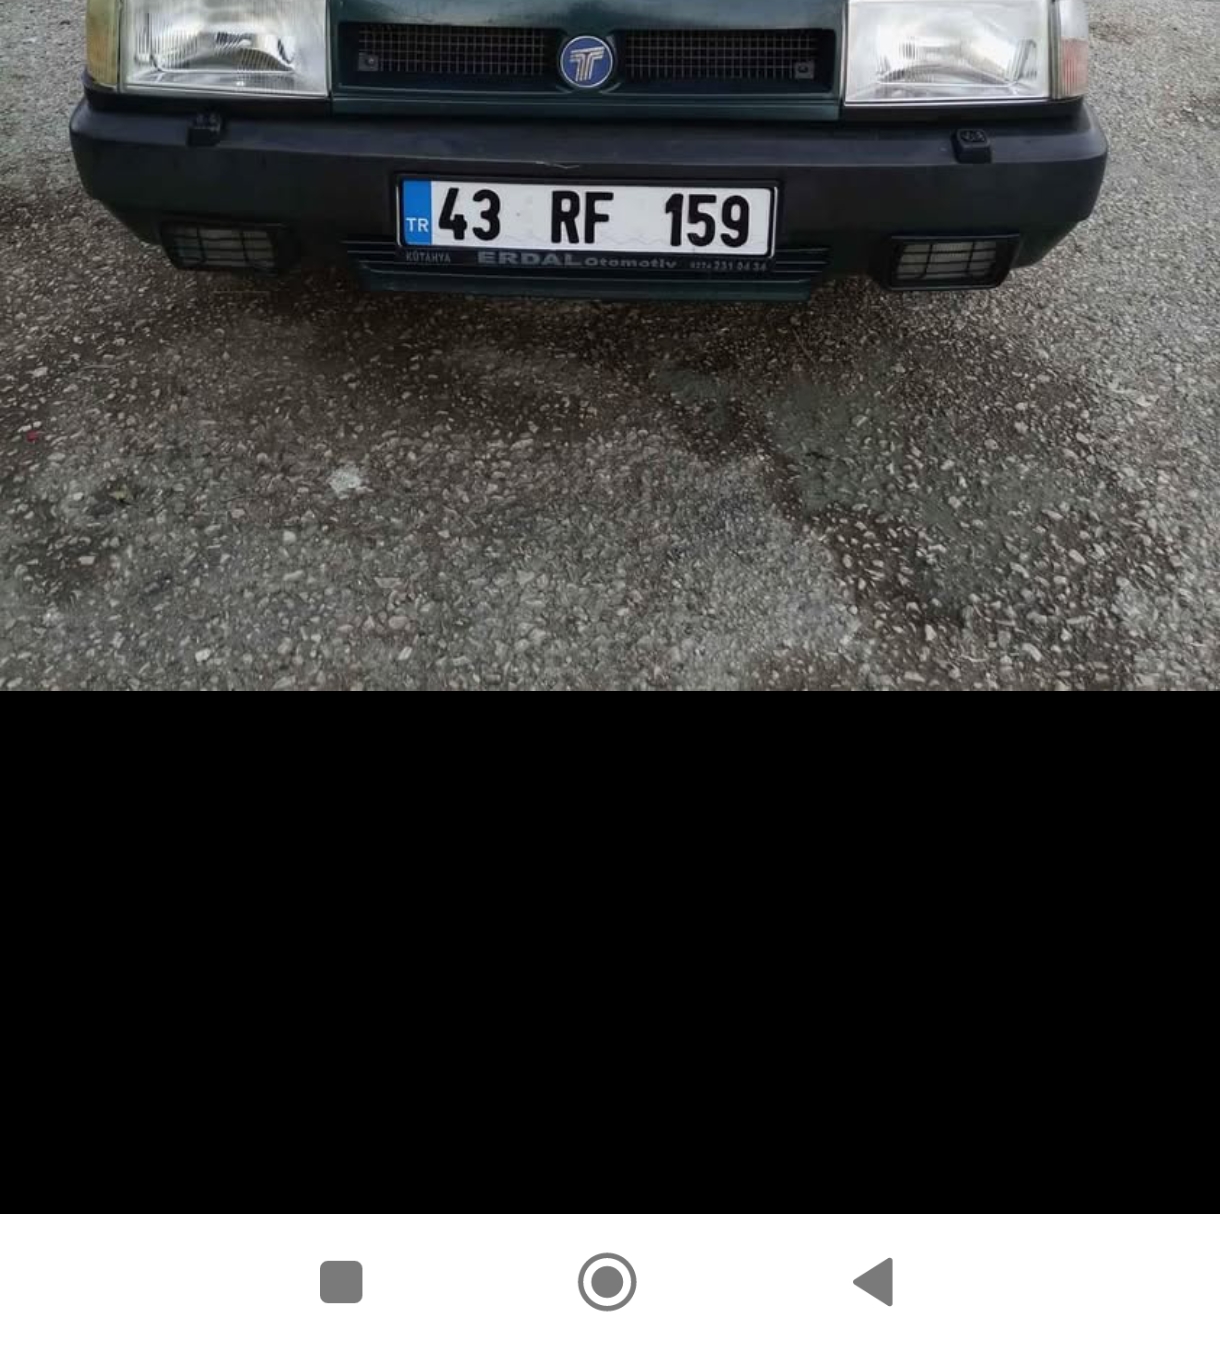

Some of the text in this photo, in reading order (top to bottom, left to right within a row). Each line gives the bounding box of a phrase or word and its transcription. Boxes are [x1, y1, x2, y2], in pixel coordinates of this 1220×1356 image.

[405, 217, 430, 233] TR
[439, 187, 750, 248] 43 RF 159
[477, 251, 581, 266] ERDAL
